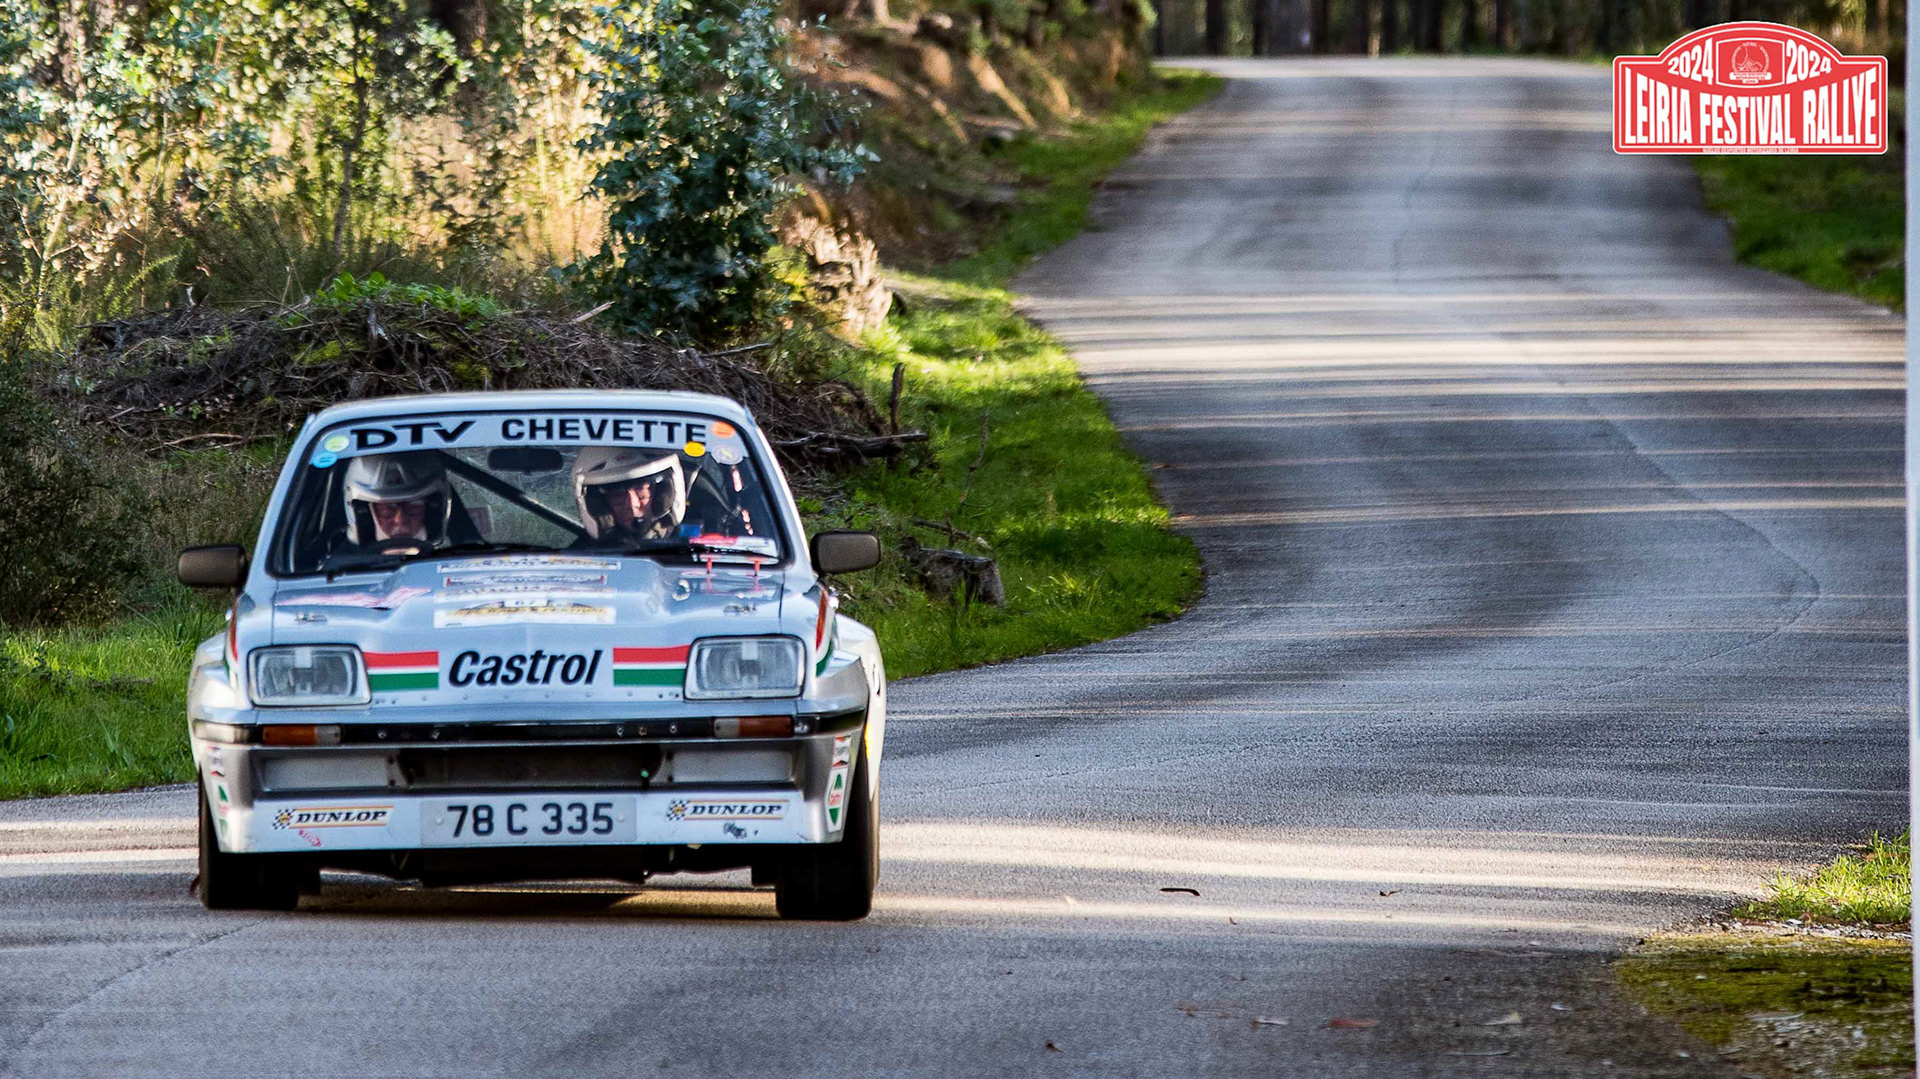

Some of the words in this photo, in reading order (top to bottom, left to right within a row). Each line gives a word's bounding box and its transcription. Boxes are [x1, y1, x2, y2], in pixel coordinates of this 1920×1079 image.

[350, 420, 476, 451] DTV
[501, 418, 706, 445] CHEVETTE
[449, 650, 603, 687] Castrol
[296, 811, 386, 822] DUNLOP
[447, 804, 494, 837] 78
[507, 803, 528, 836] C
[542, 803, 614, 836] 335
[690, 805, 782, 815] DUNLOP
